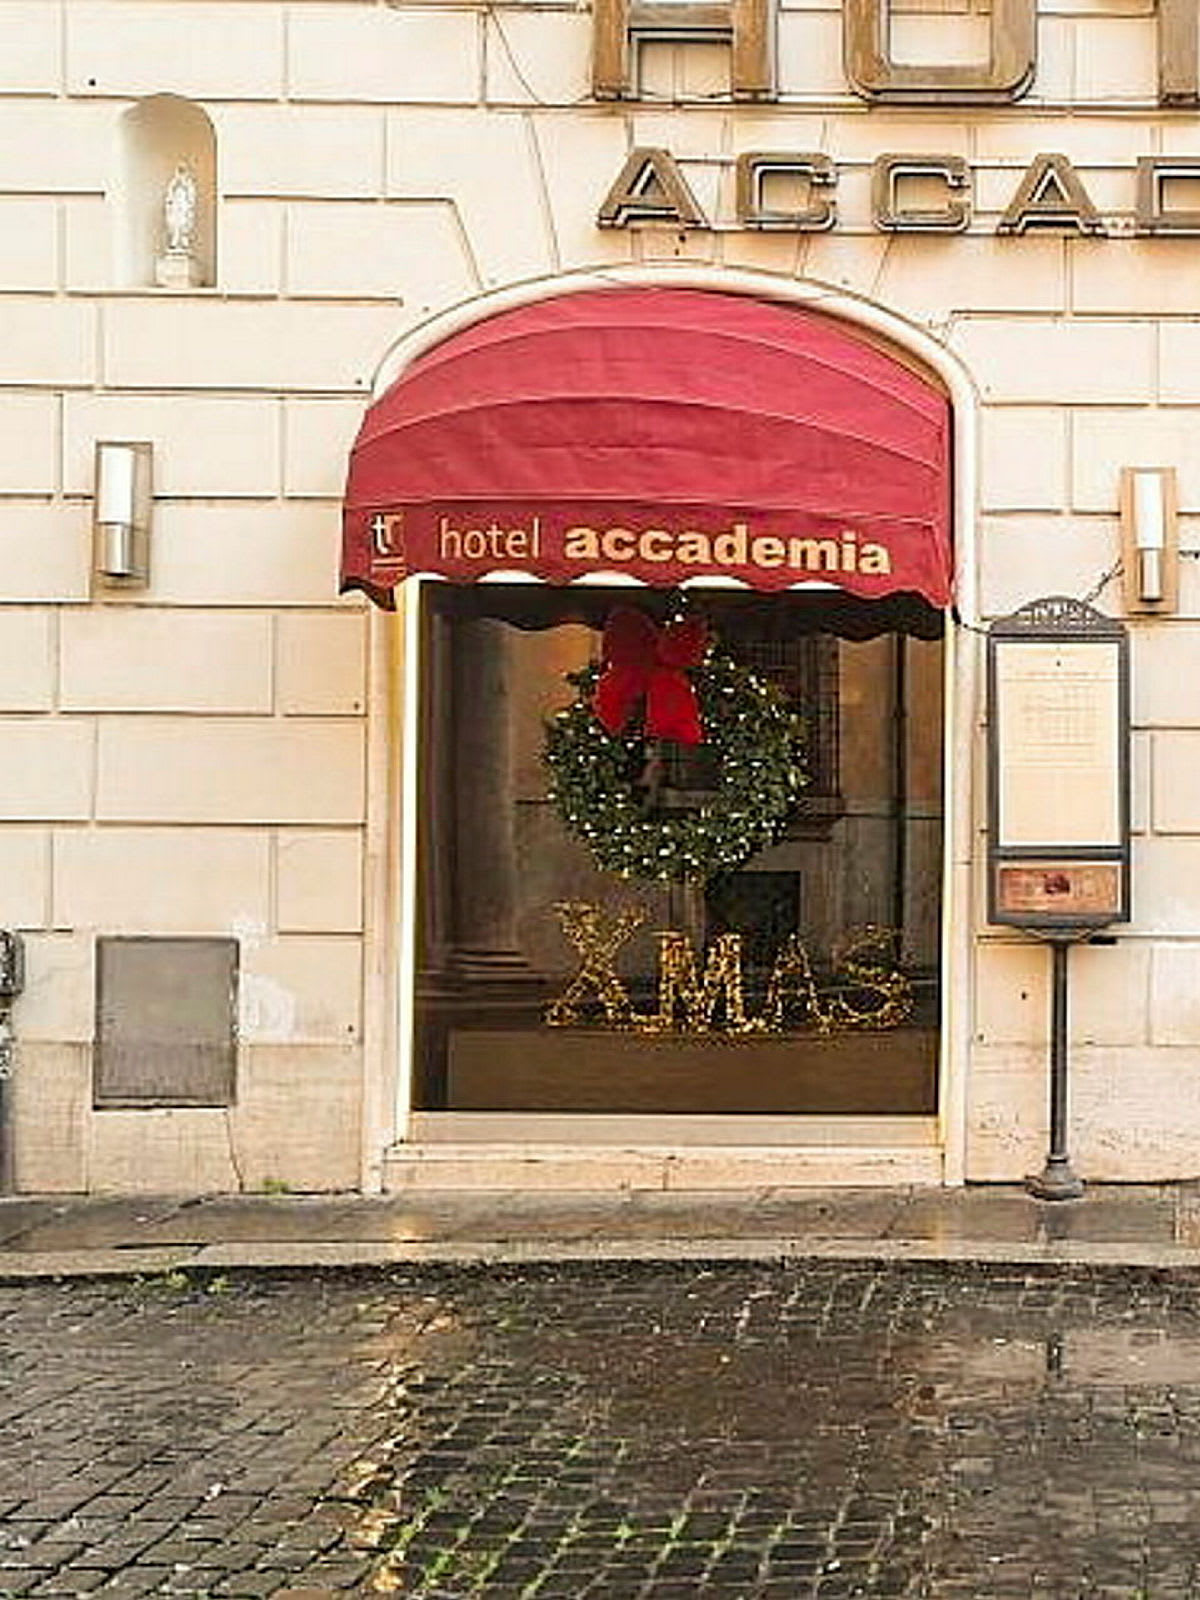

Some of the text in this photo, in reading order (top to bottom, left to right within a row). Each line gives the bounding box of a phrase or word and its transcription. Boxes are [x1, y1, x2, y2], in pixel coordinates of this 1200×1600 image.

[439, 516, 893, 575] hotel accademia
[539, 900, 916, 1034] XMAS
